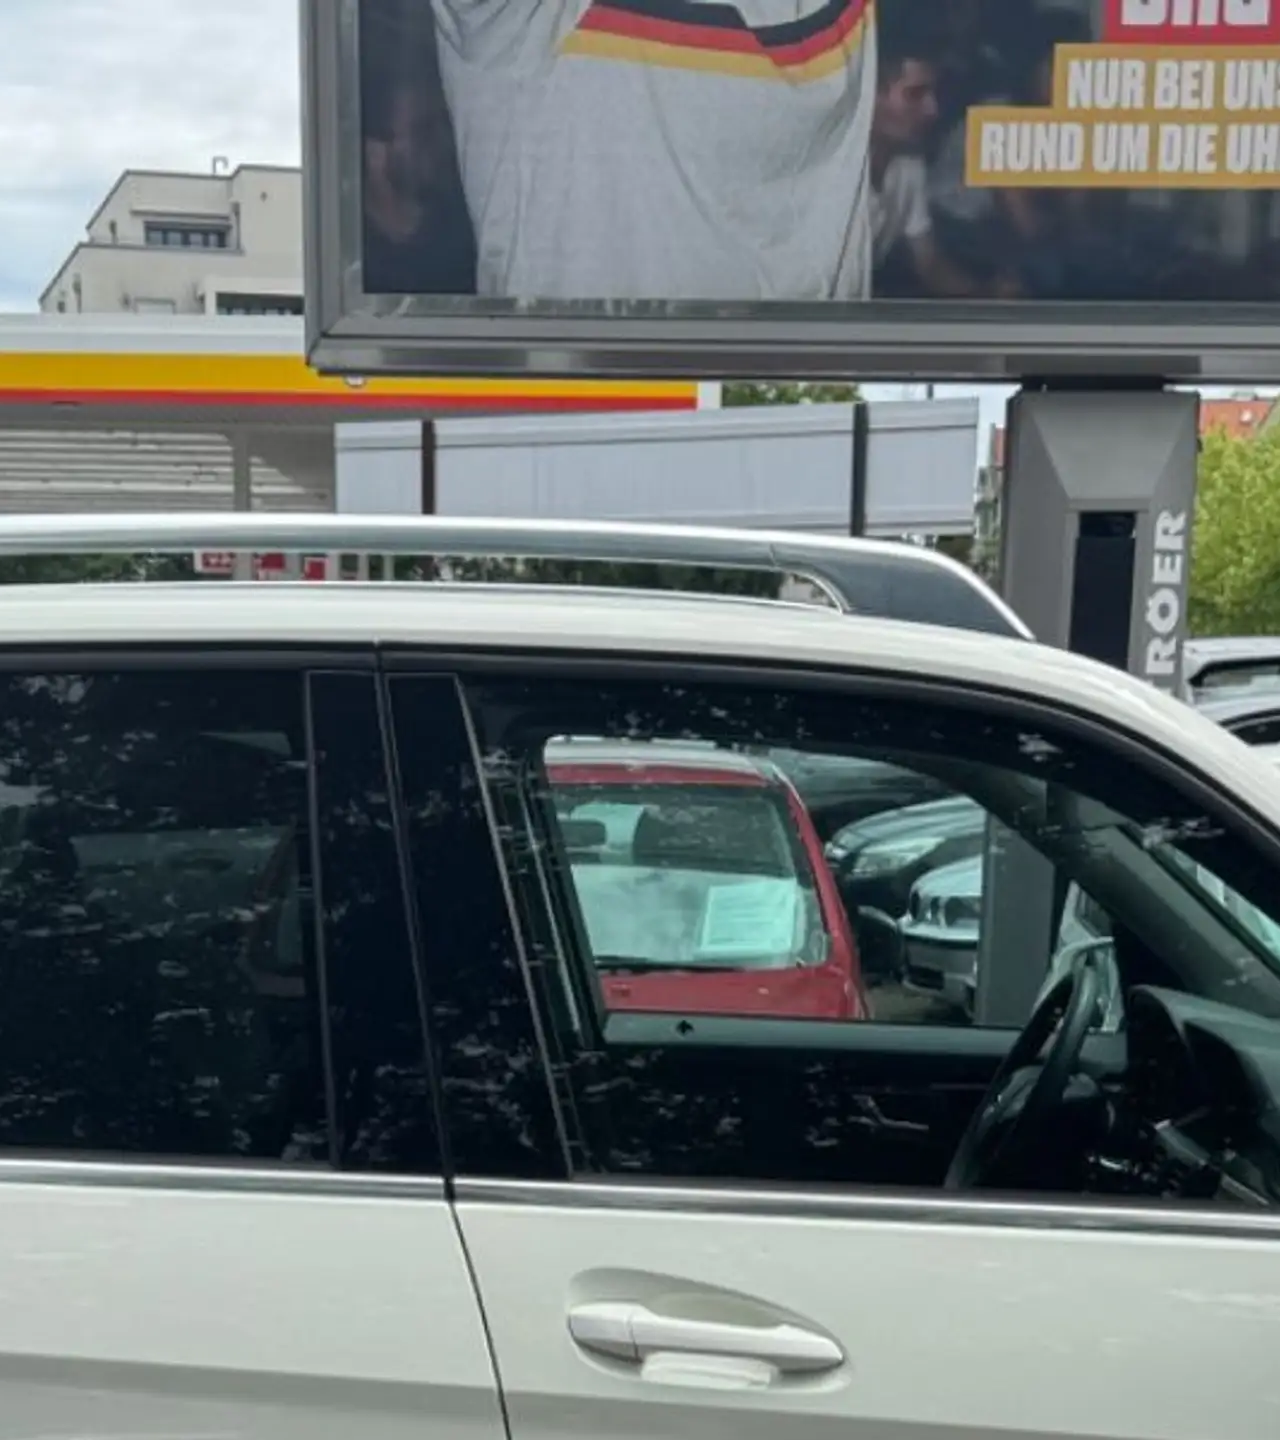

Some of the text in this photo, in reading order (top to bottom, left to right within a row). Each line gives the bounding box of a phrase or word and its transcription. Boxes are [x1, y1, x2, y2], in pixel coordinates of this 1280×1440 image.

[1066, 58, 1147, 110] NUR
[1153, 58, 1215, 110] BEI
[979, 121, 1085, 173] RUND
[1092, 122, 1150, 173] UM
[1157, 122, 1219, 173] DIE
